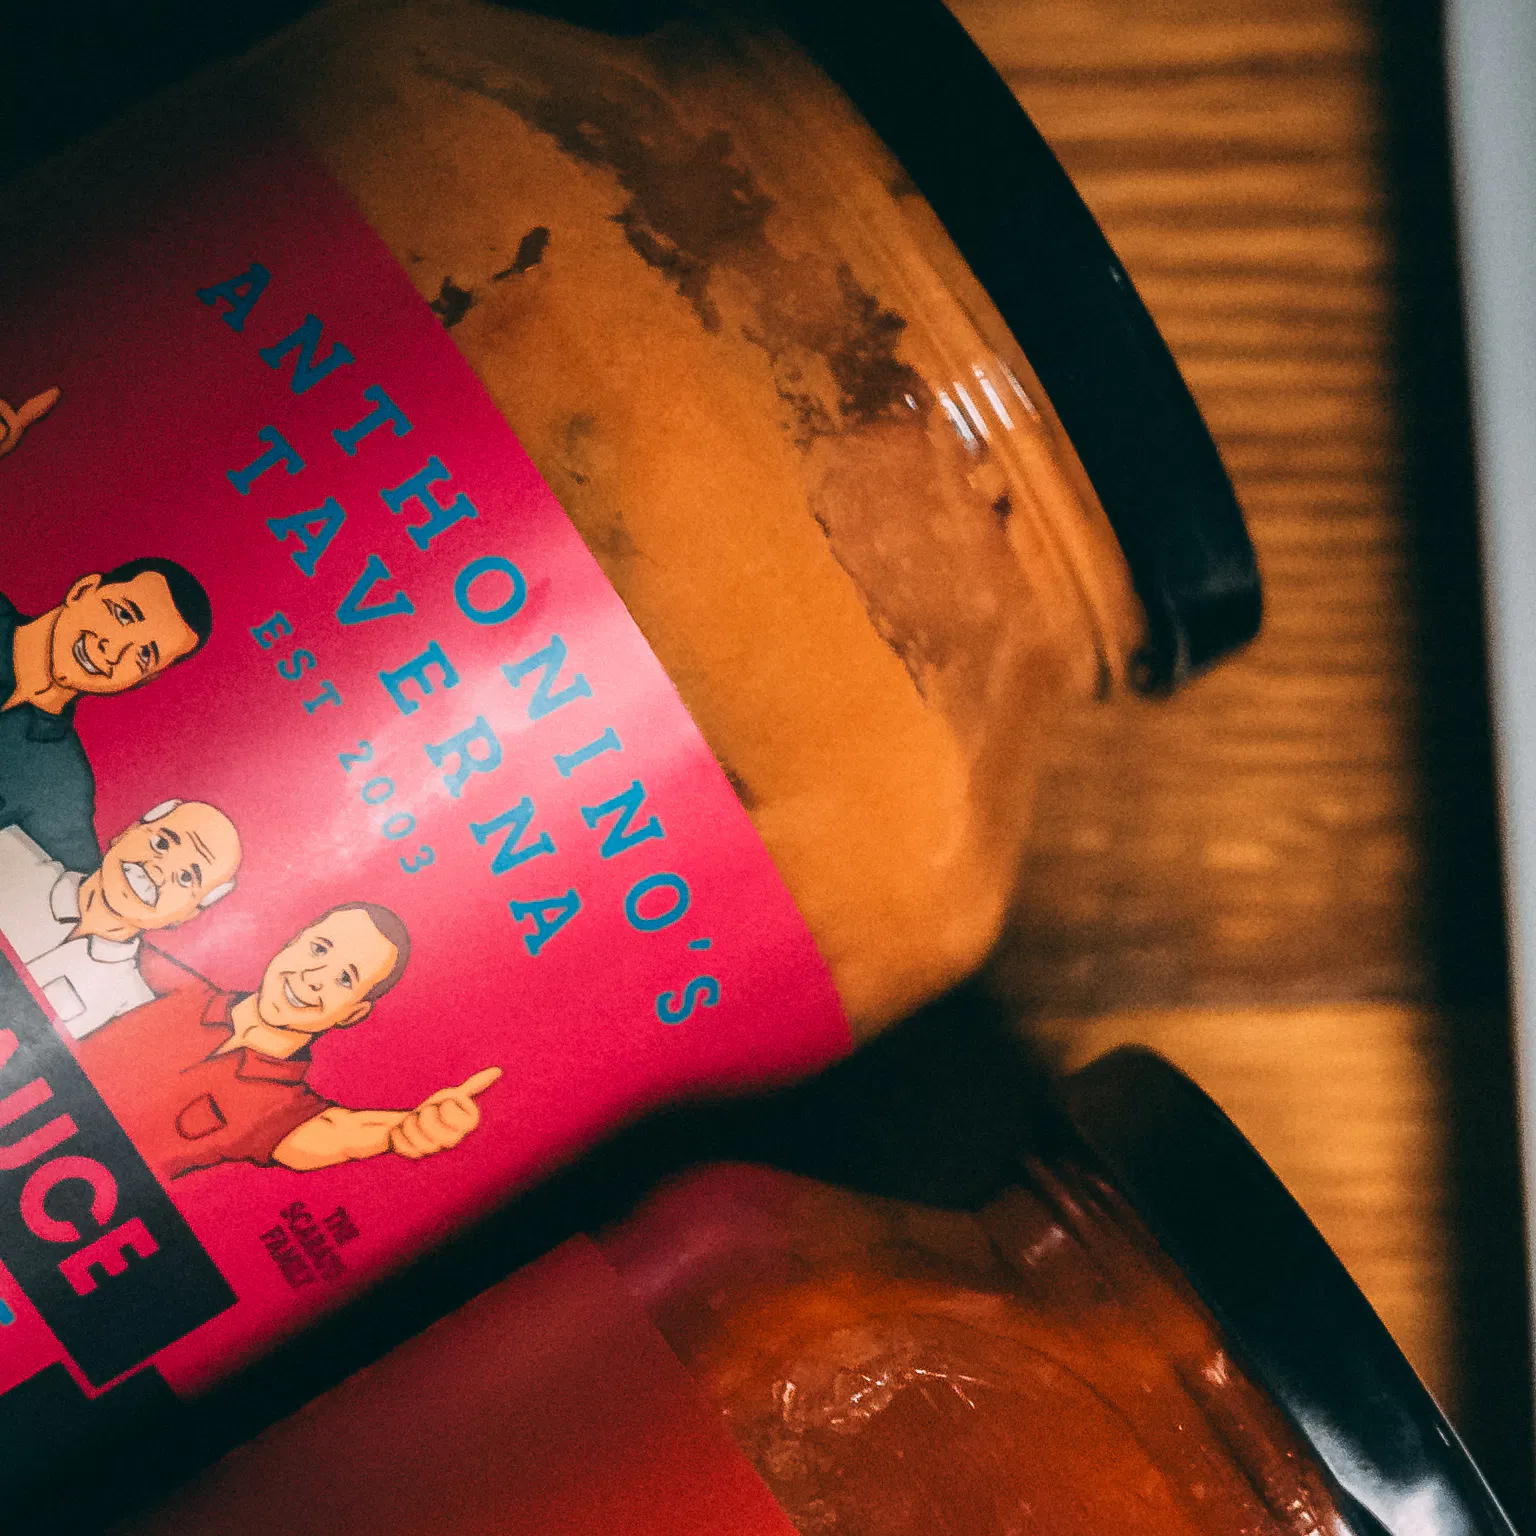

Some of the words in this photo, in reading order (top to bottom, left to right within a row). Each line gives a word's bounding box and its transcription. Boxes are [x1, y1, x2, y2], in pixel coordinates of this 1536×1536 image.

[199, 262, 722, 1026] ANTHONINO'S
[226, 425, 583, 957] TAVERNA
[251, 610, 343, 717] EST
[338, 740, 436, 876] 2003
[0, 1028, 160, 1297] UCE
